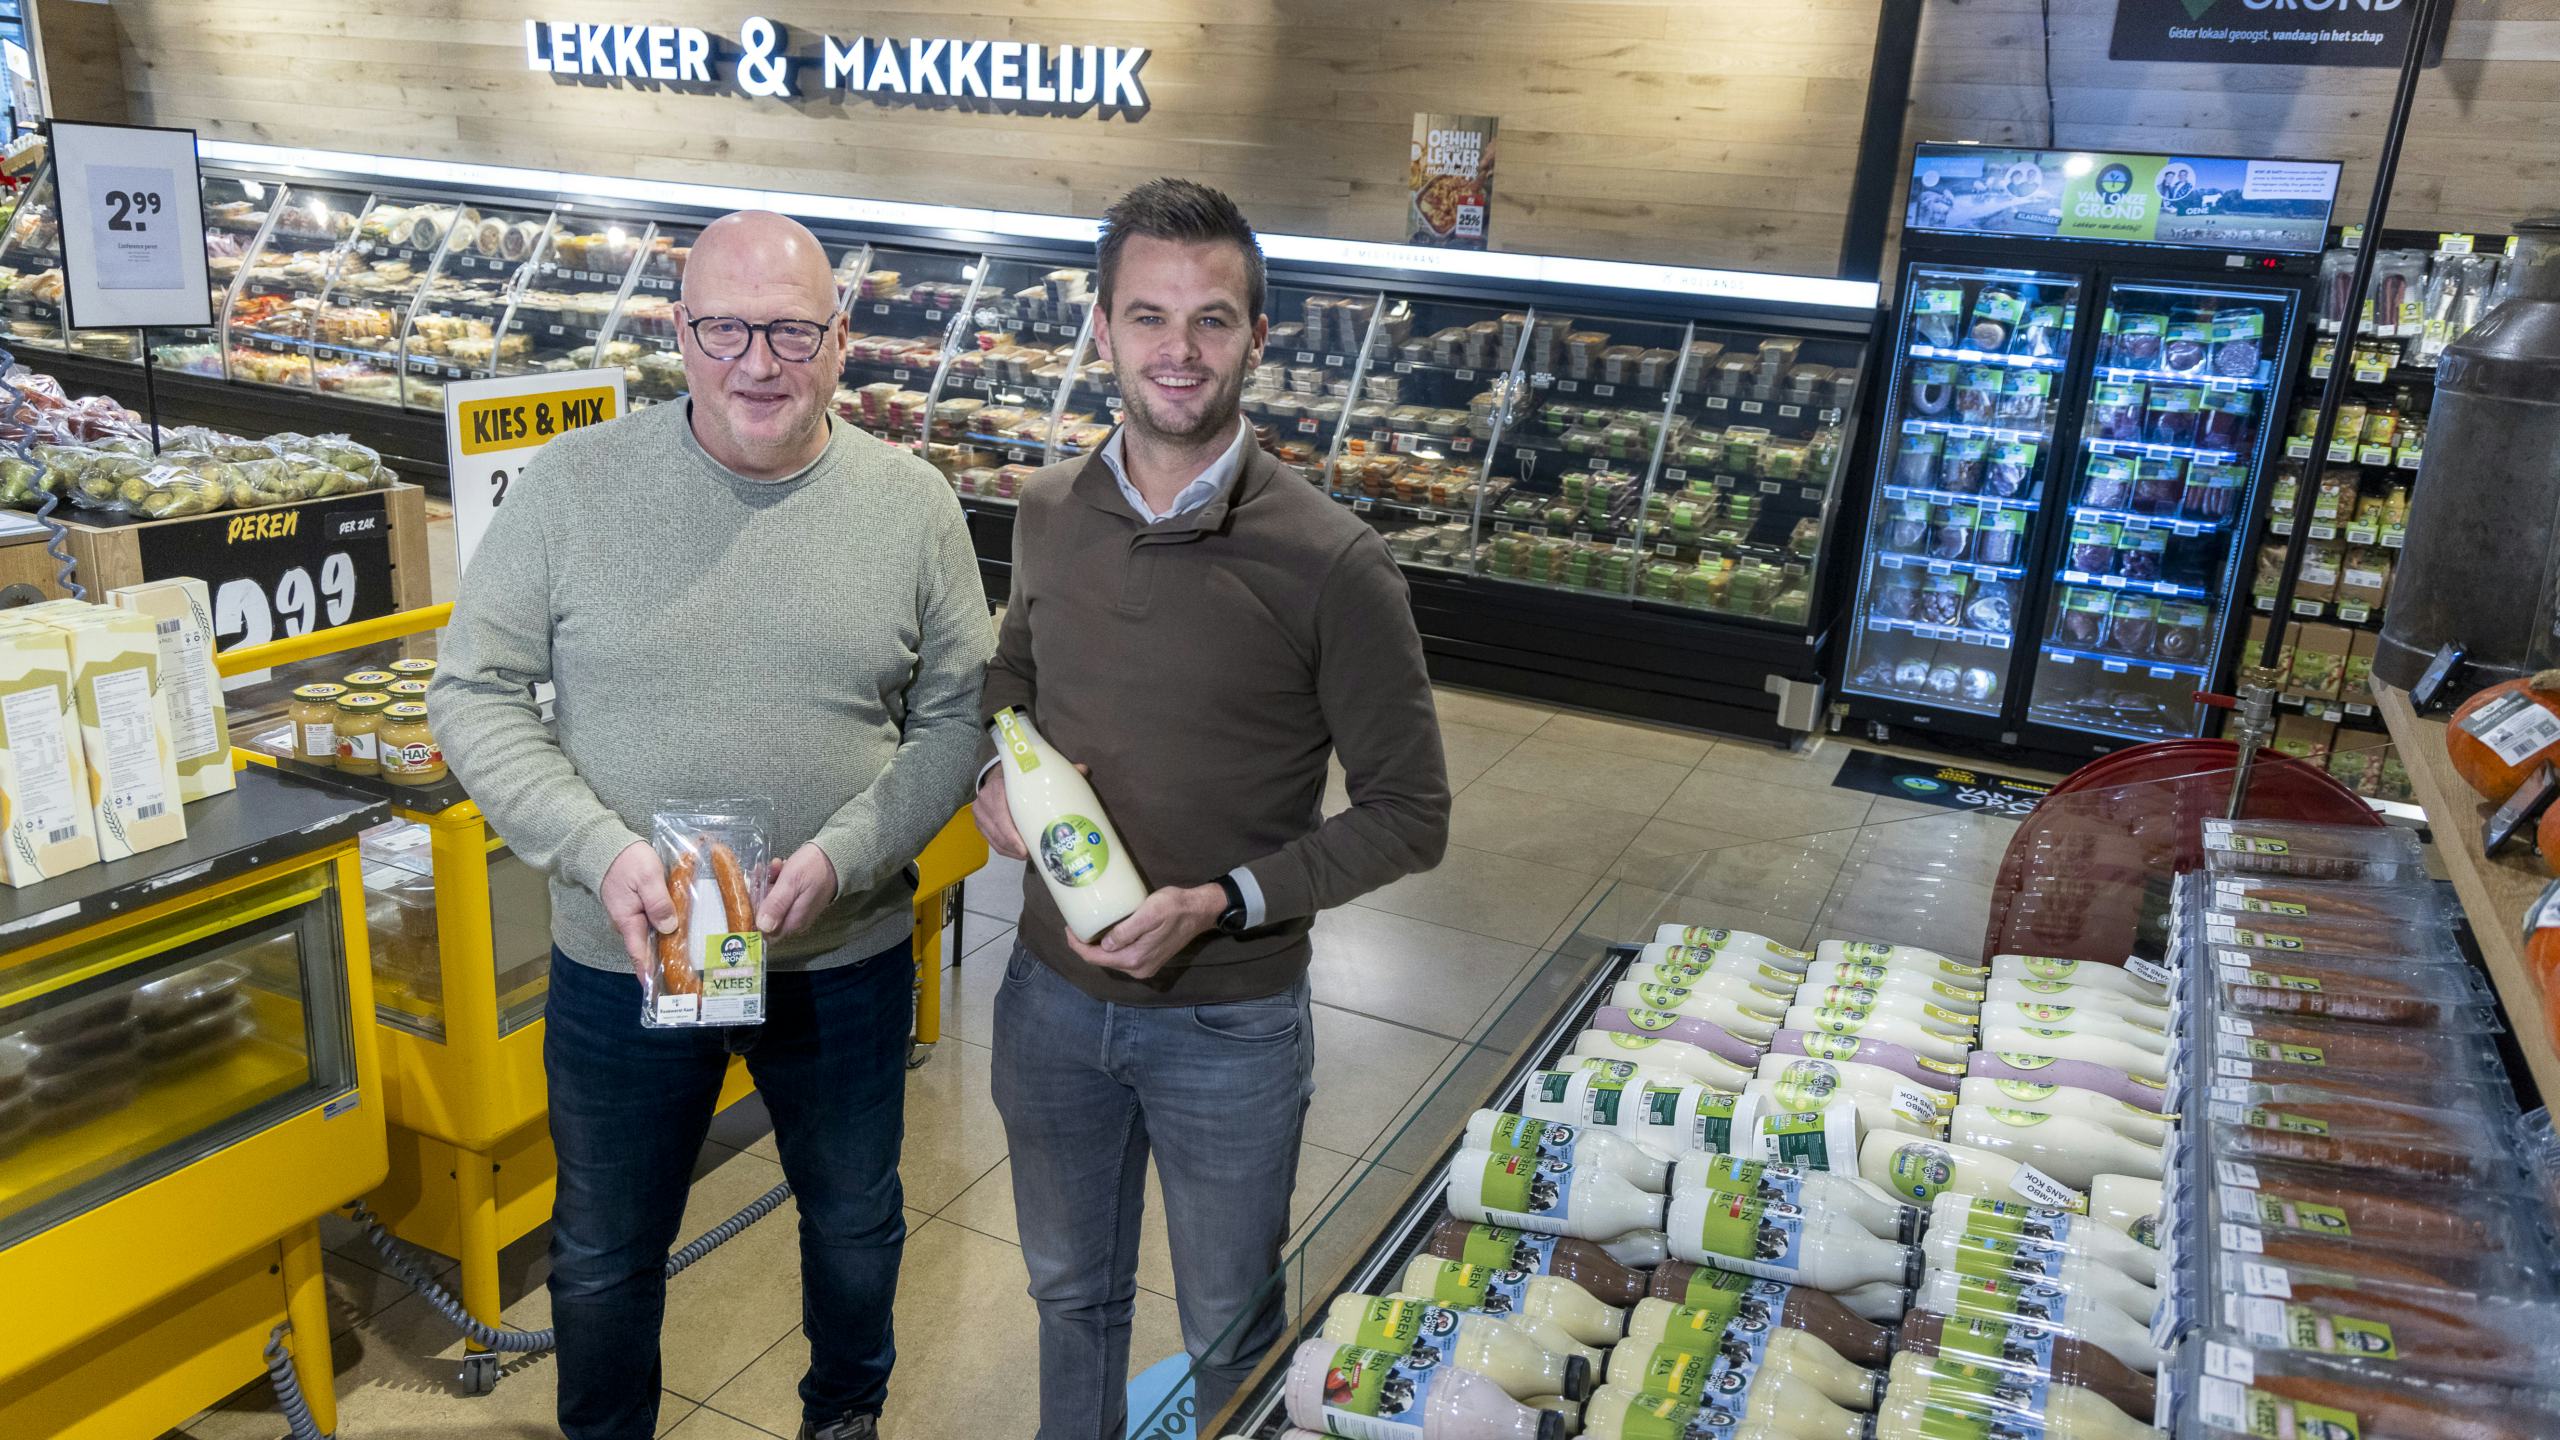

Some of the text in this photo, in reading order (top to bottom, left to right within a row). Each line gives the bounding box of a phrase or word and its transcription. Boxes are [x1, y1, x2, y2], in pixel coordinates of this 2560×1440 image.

[2169, 27, 2384, 45] Gister lokaal geoogst, vandaag in het schap
[525, 16, 1147, 107] LEKKER & MAKKELIJK
[1427, 147, 1480, 166] LEKKER
[2077, 191, 2148, 206] VAN ONZE
[105, 190, 161, 231] 2.99
[1458, 214, 1481, 226] 25%
[2074, 203, 2145, 221] GROND
[473, 397, 604, 444] KIES & MIX
[227, 511, 300, 545] PEREN
[338, 517, 375, 535] PER ZAK
[1000, 714, 1028, 755] BIO
[402, 748, 430, 761] HAK
[1955, 792, 2039, 815] GRO
[1958, 785, 2014, 802] VAN
[713, 977, 753, 990] VLEES
[1900, 1091, 1918, 1101] KOK
[1905, 1101, 1931, 1119] JUMBO
[1520, 1120, 1538, 1150] OEREN
[1903, 1154, 1916, 1178] MELK
[2025, 1171, 2071, 1205] HANS KOK
[1395, 1301, 1416, 1341] OEREN
[1342, 1347, 1364, 1373] HURT
